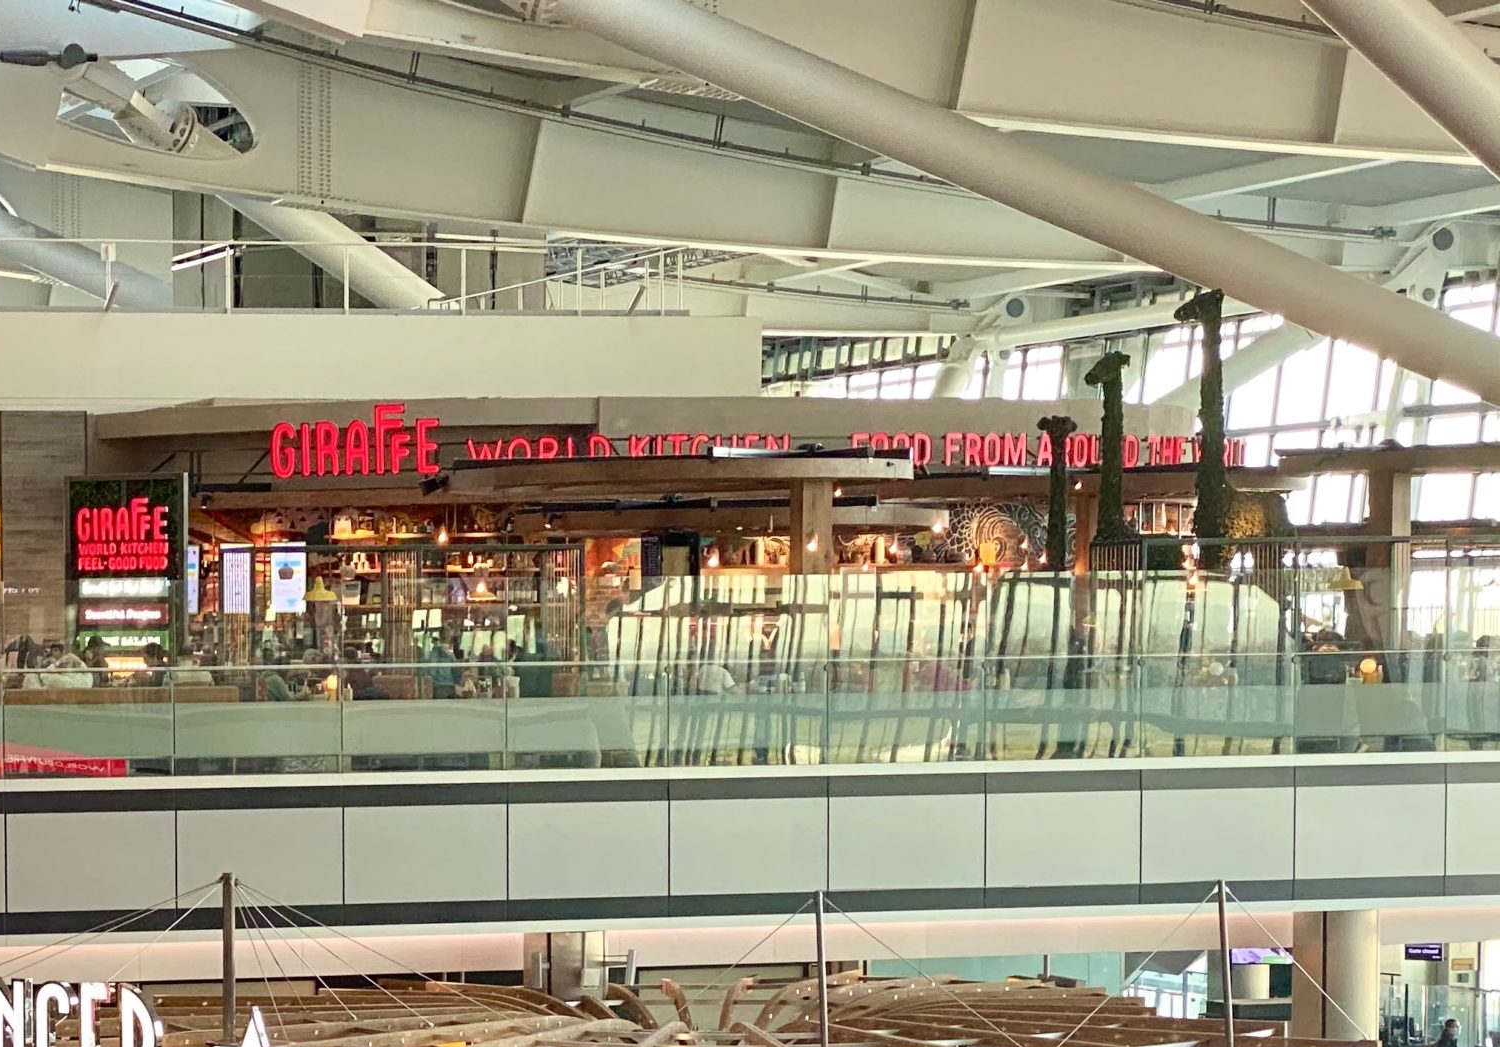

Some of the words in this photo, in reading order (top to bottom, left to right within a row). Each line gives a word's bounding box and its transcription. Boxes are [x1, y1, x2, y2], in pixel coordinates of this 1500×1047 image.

[270, 403, 440, 479] GIRAFFE
[944, 432, 1028, 467] FROM
[1037, 431, 1140, 468] AROUD
[1146, 434, 1188, 467] THE
[76, 497, 170, 542] GIRAFFE
[78, 542, 117, 557] WORLD
[120, 541, 169, 556] KITCHEN
[138, 556, 169, 571] FOOD
